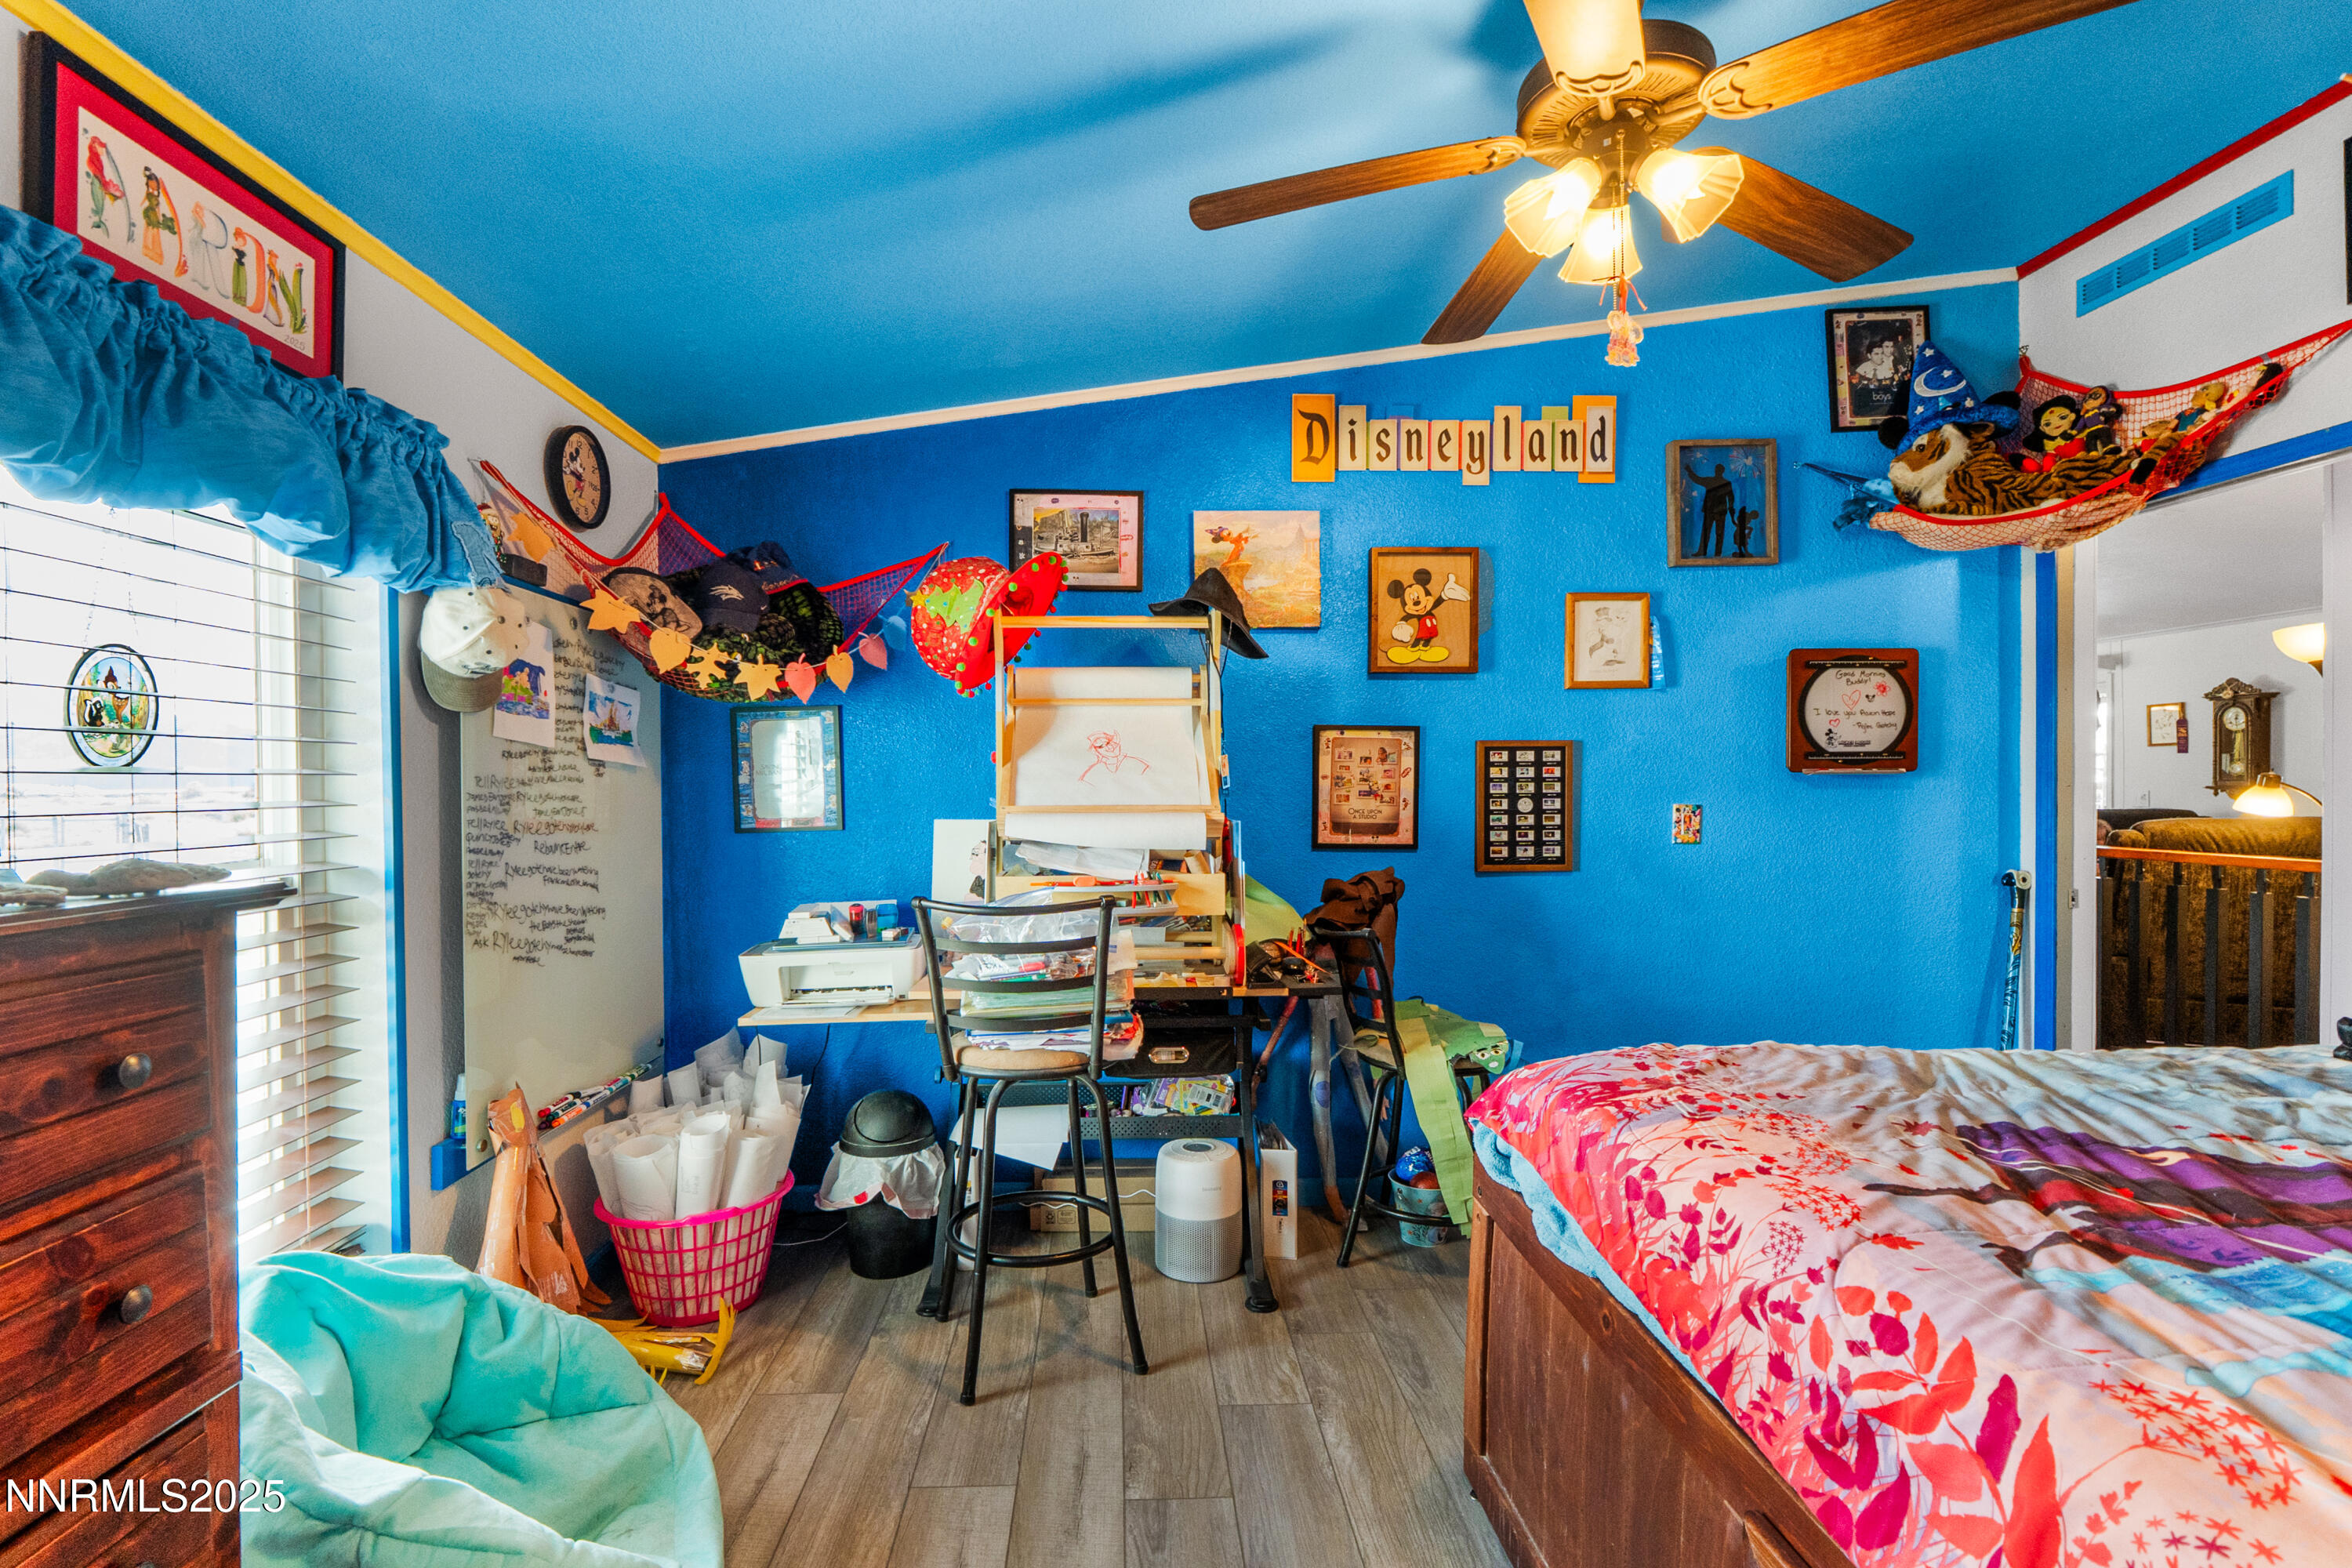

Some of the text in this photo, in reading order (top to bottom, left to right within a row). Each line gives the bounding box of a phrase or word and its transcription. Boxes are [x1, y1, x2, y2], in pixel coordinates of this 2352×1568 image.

[284, 335, 306, 351] 2025
[1872, 391, 1892, 402] boys
[1298, 408, 1607, 475] Disneyland
[1835, 670, 1856, 680] Good
